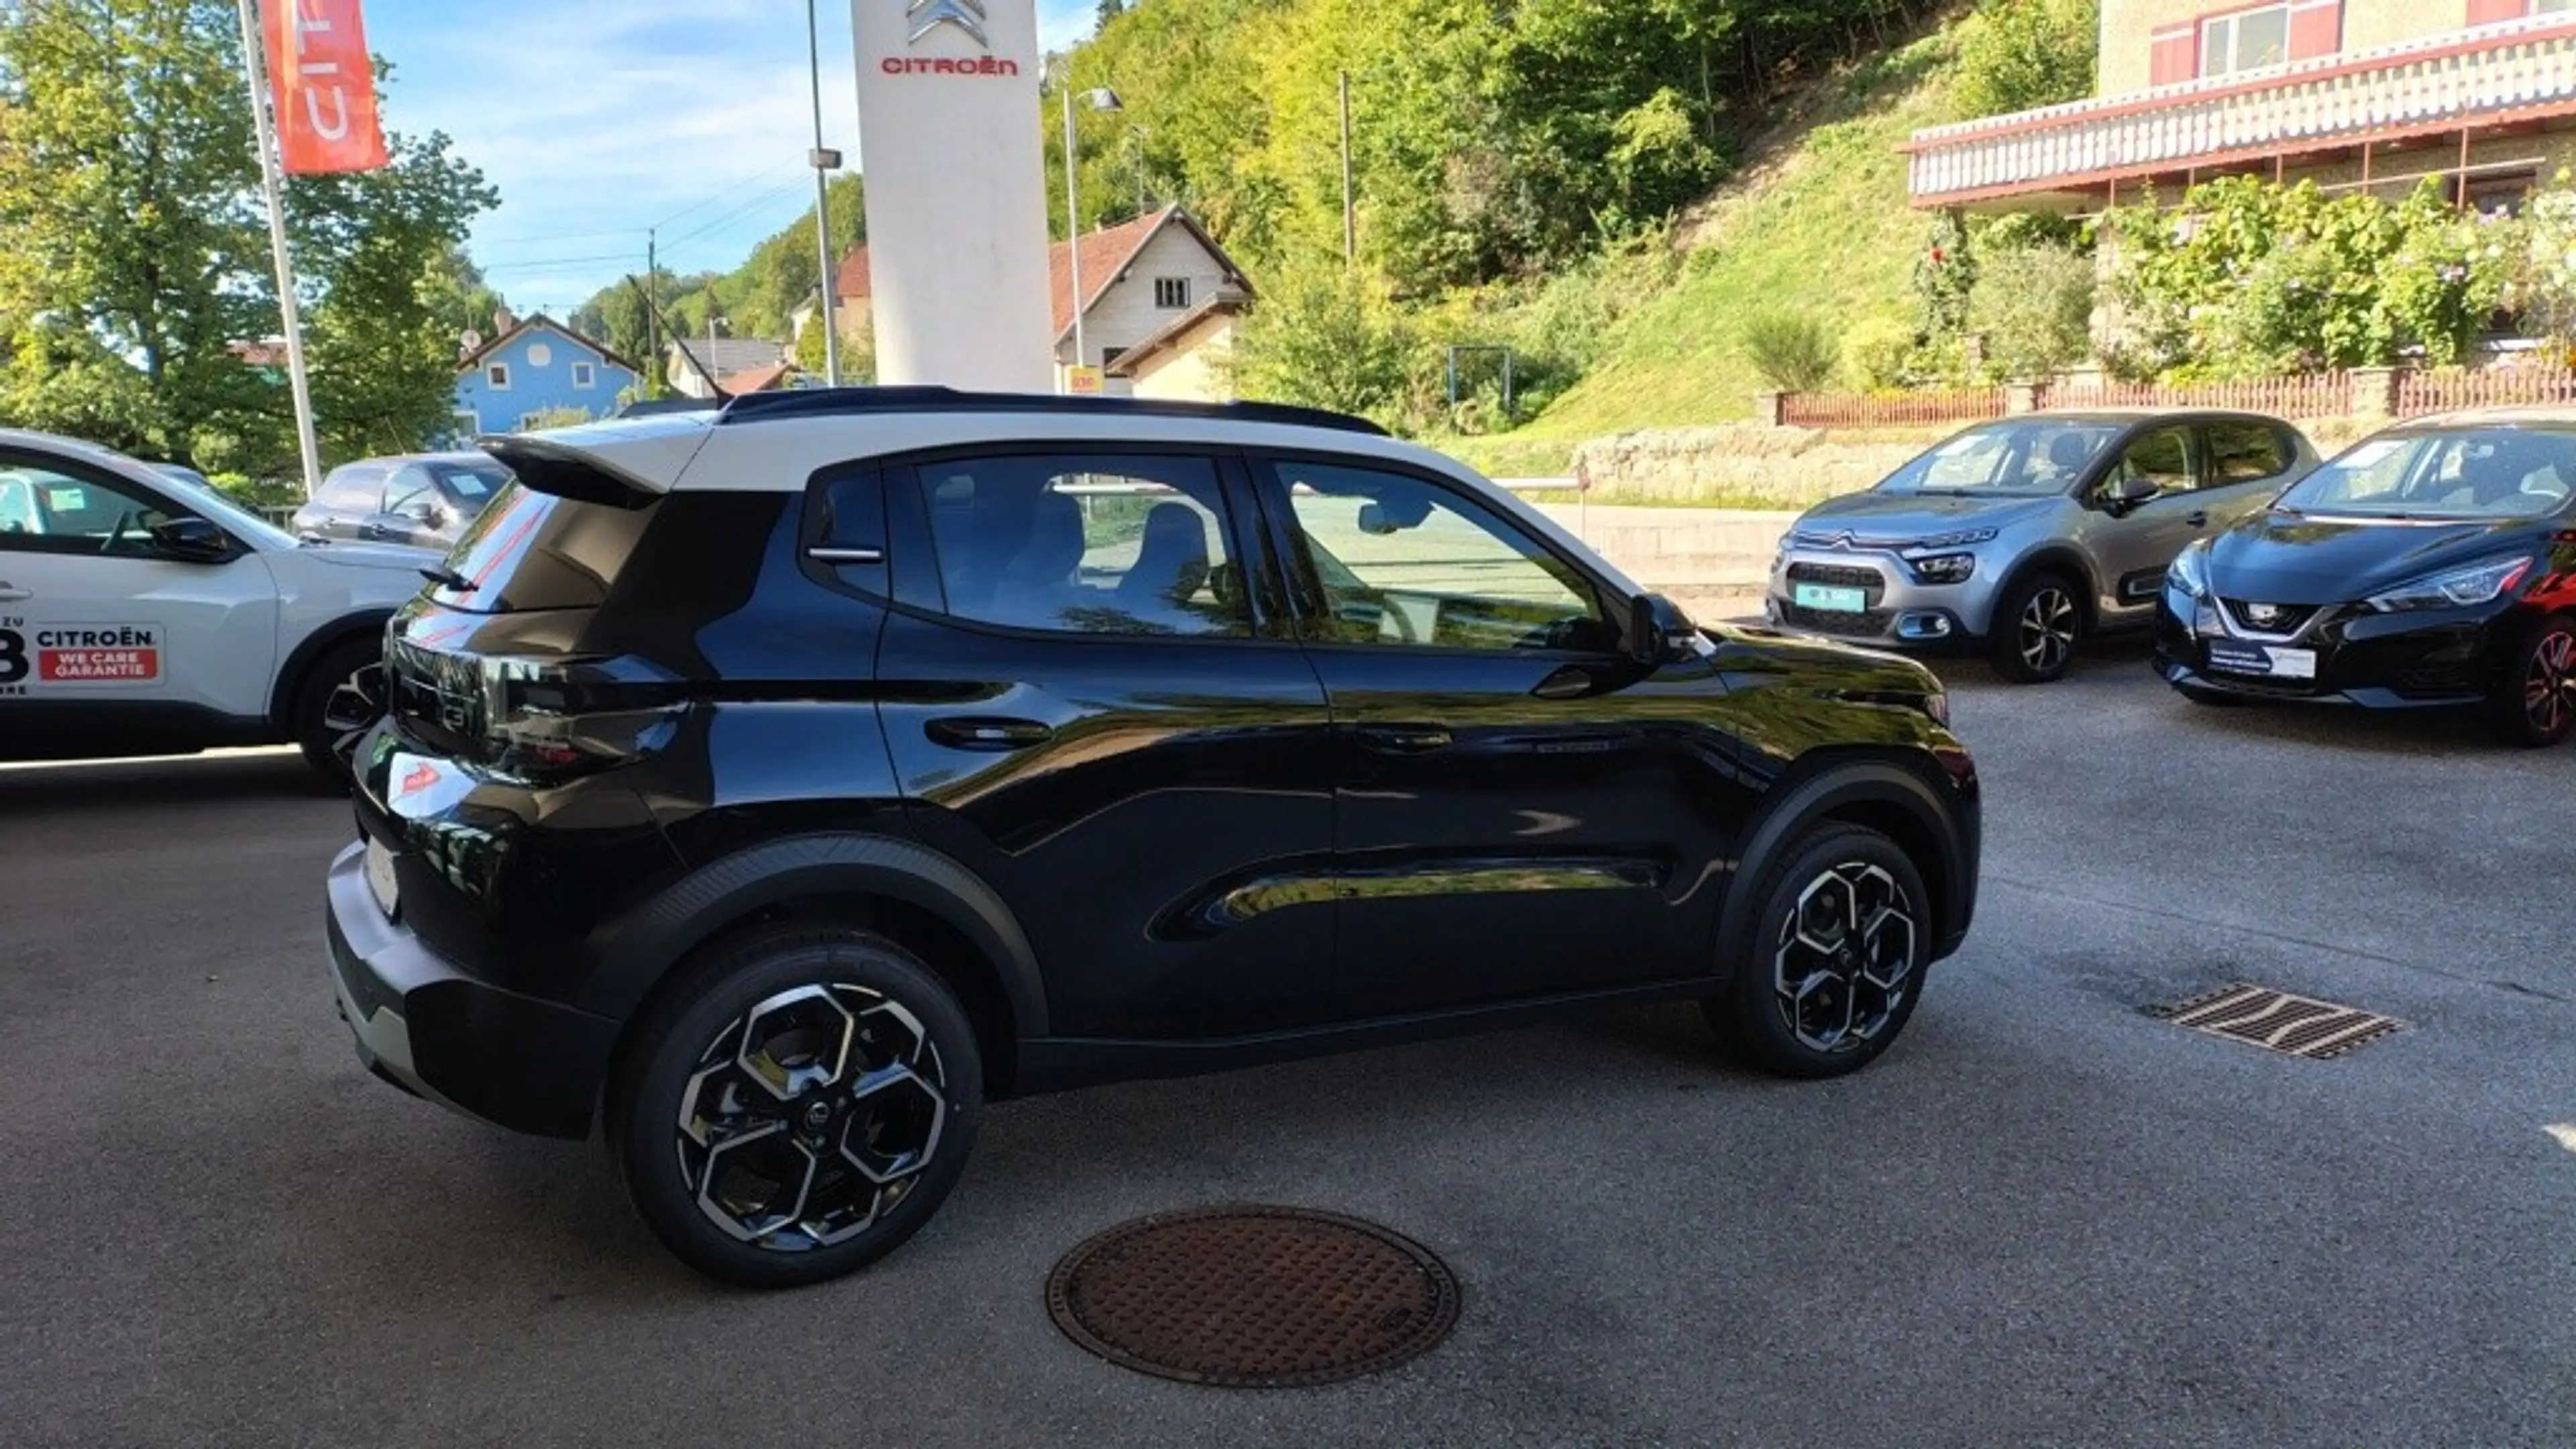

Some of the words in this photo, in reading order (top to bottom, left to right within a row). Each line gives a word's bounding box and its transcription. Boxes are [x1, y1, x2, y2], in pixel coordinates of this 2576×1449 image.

[881, 55, 1018, 76] CITROËN
[37, 626, 152, 647] CITROËN
[58, 652, 88, 663] WE
[91, 651, 140, 663] CARE
[55, 663, 146, 678] GARANTIE
